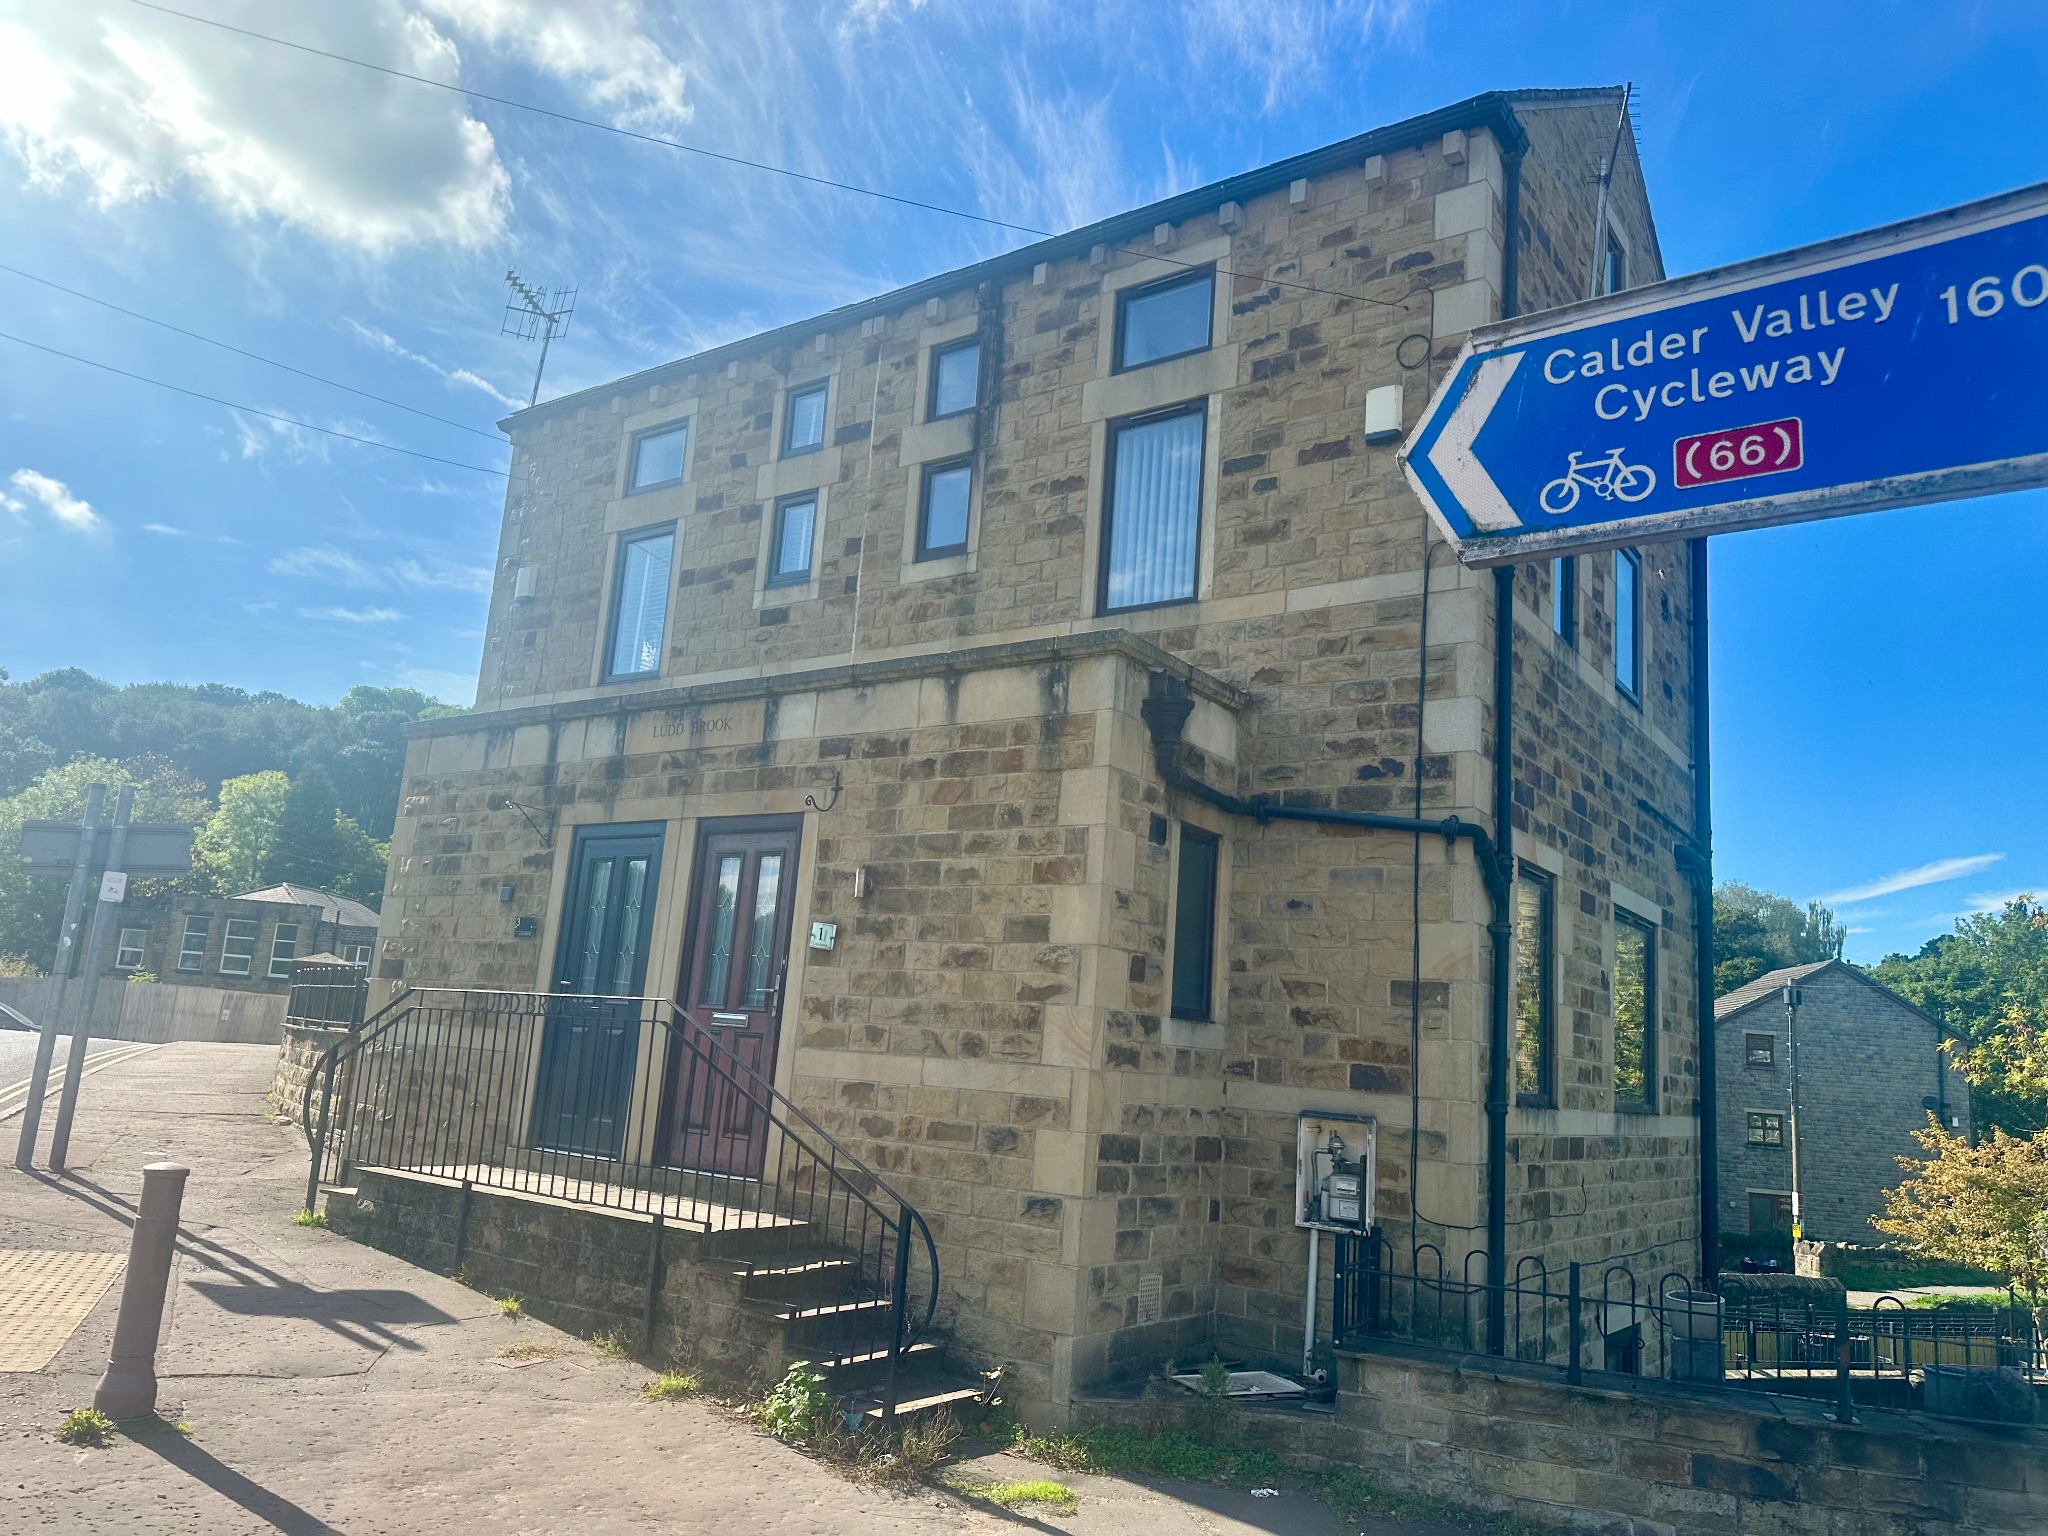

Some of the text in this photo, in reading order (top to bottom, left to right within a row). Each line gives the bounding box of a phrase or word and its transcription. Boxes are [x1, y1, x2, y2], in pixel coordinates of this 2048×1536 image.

[1543, 264, 2048, 386] Calder Valley 160
[1594, 347, 1846, 423] Cycleway
[1684, 426, 1793, 480] (66)
[653, 718, 732, 737] LUDD BROOK
[516, 917, 521, 926] 3
